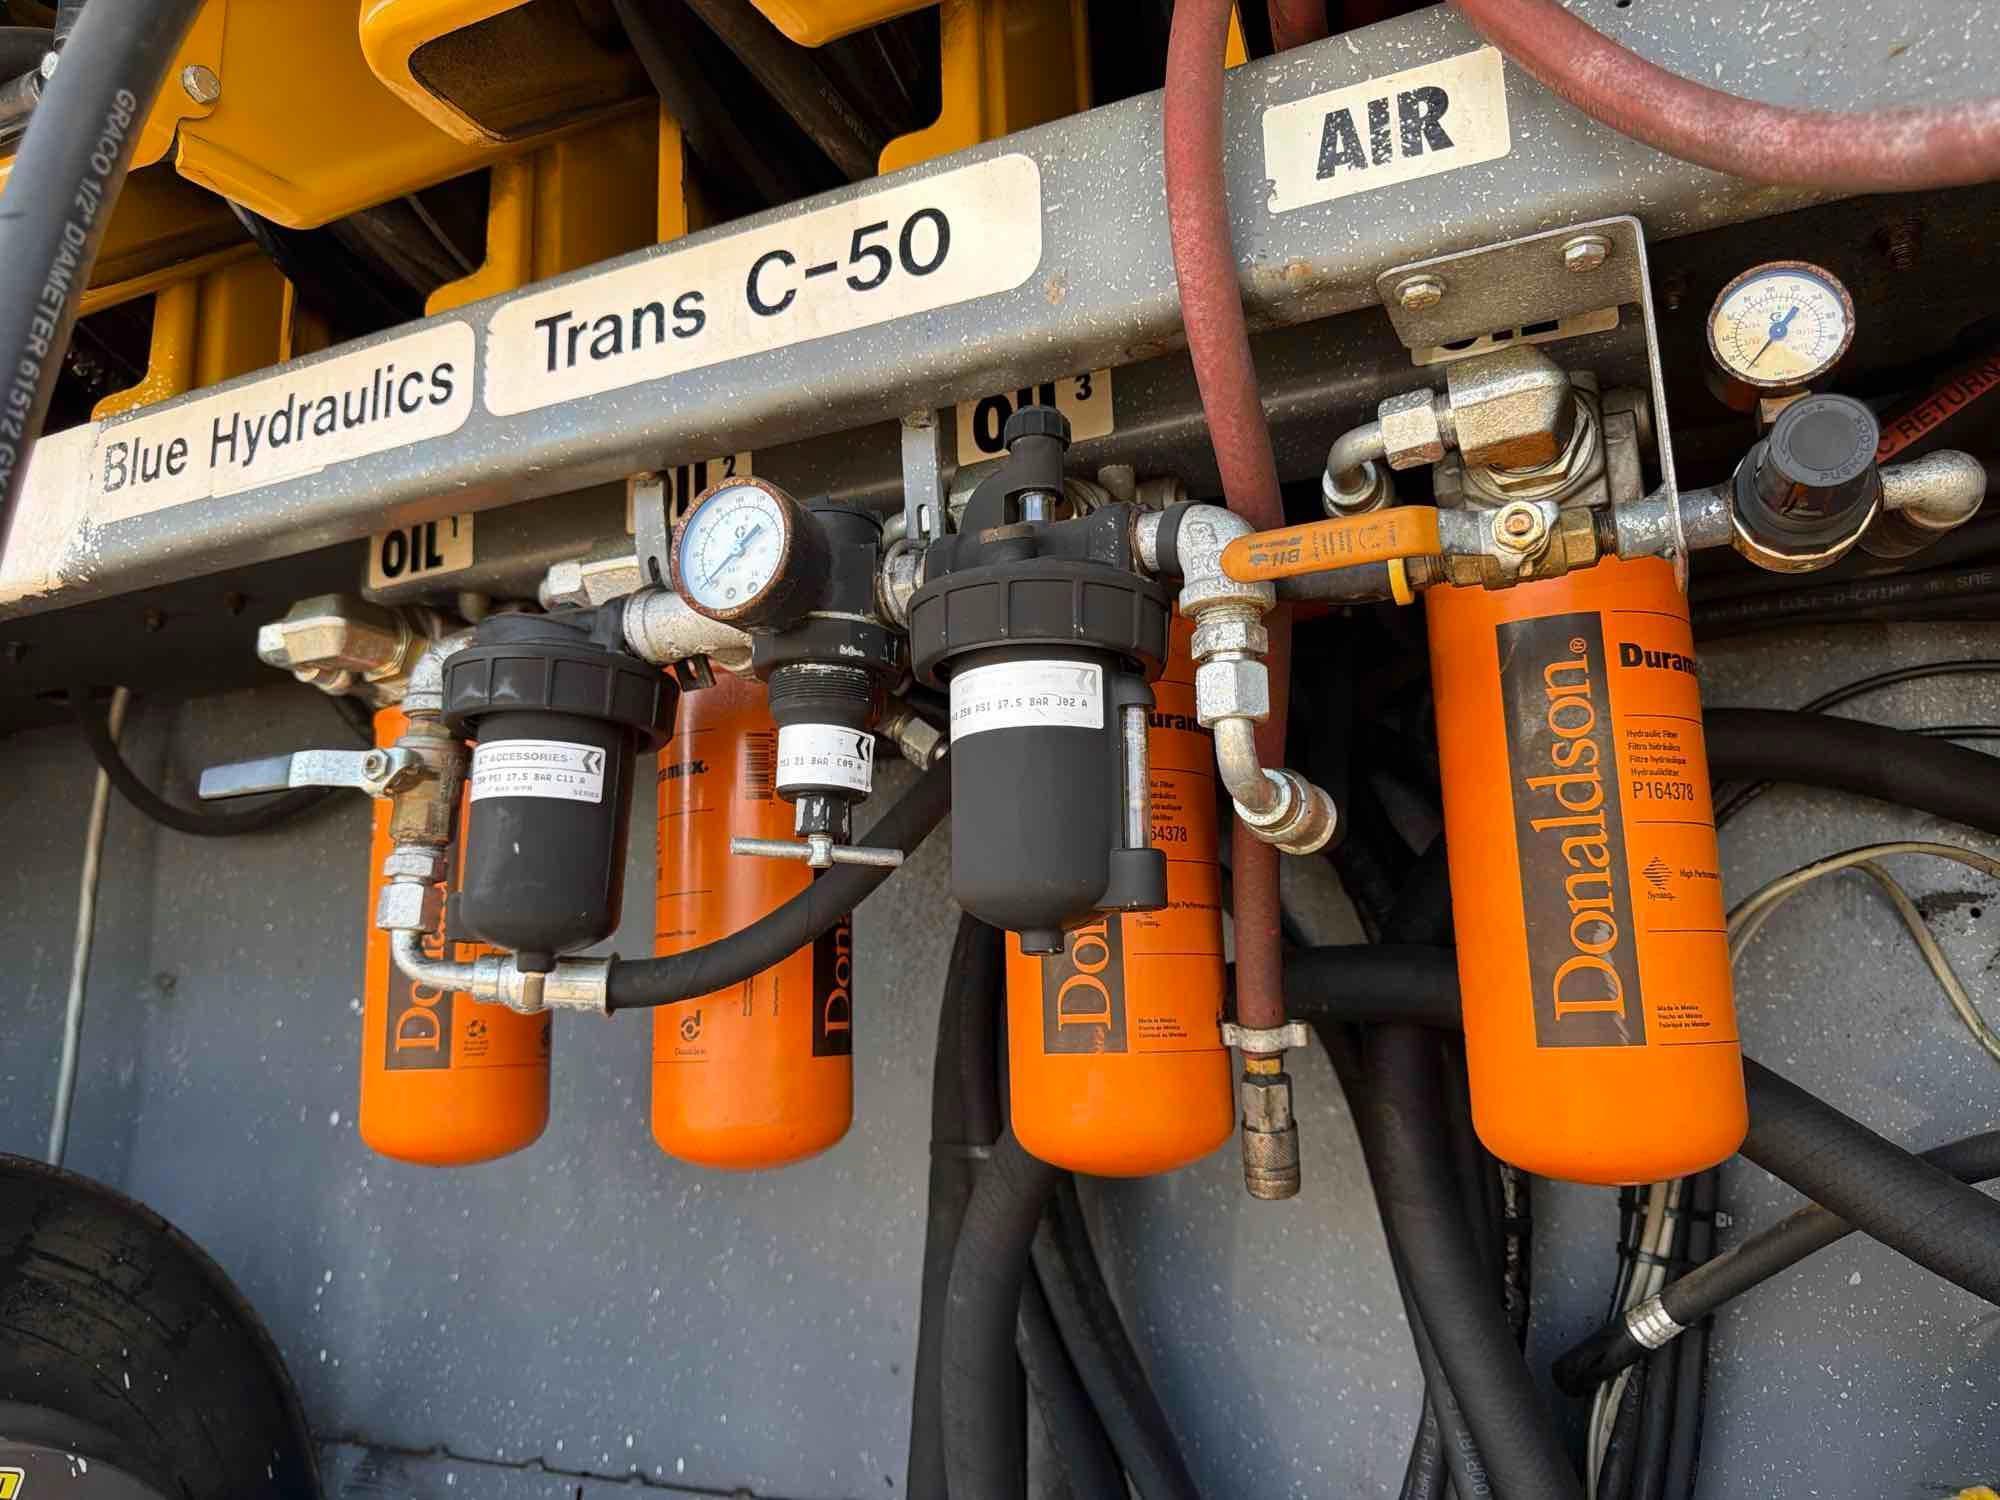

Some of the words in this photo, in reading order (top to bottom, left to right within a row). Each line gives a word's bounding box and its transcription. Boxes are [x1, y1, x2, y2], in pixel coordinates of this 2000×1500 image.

[89, 88, 137, 176] GRACO
[1316, 86, 1455, 180] AIR
[26, 220, 87, 359] DIAMETER
[534, 290, 706, 373] Trans
[745, 207, 951, 317] C-50
[1, 360, 41, 440] 61512
[1075, 374, 1092, 400] 3
[103, 437, 188, 494] Blue
[209, 362, 454, 469] Hydraulics
[723, 454, 736, 478] 2
[381, 521, 444, 578] OIL
[1029, 696, 1049, 707] BAR
[1632, 780, 1695, 801] P164378
